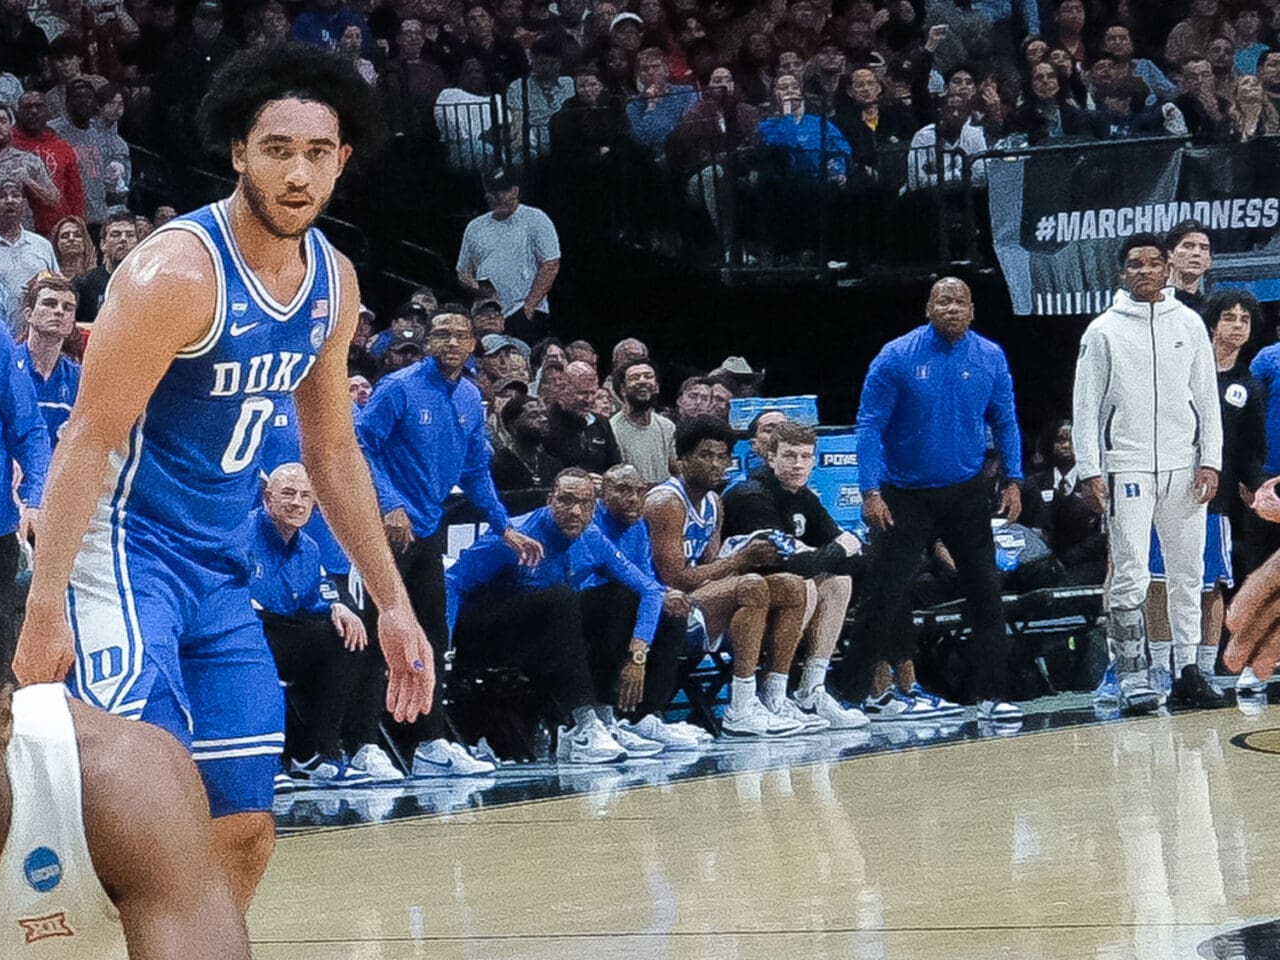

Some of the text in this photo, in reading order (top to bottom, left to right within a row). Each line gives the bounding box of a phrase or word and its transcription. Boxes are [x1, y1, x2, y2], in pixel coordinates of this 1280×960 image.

[1035, 197, 1279, 243] #MARCHMADNESS
[220, 396, 274, 474] 0
[88, 645, 123, 684] D
